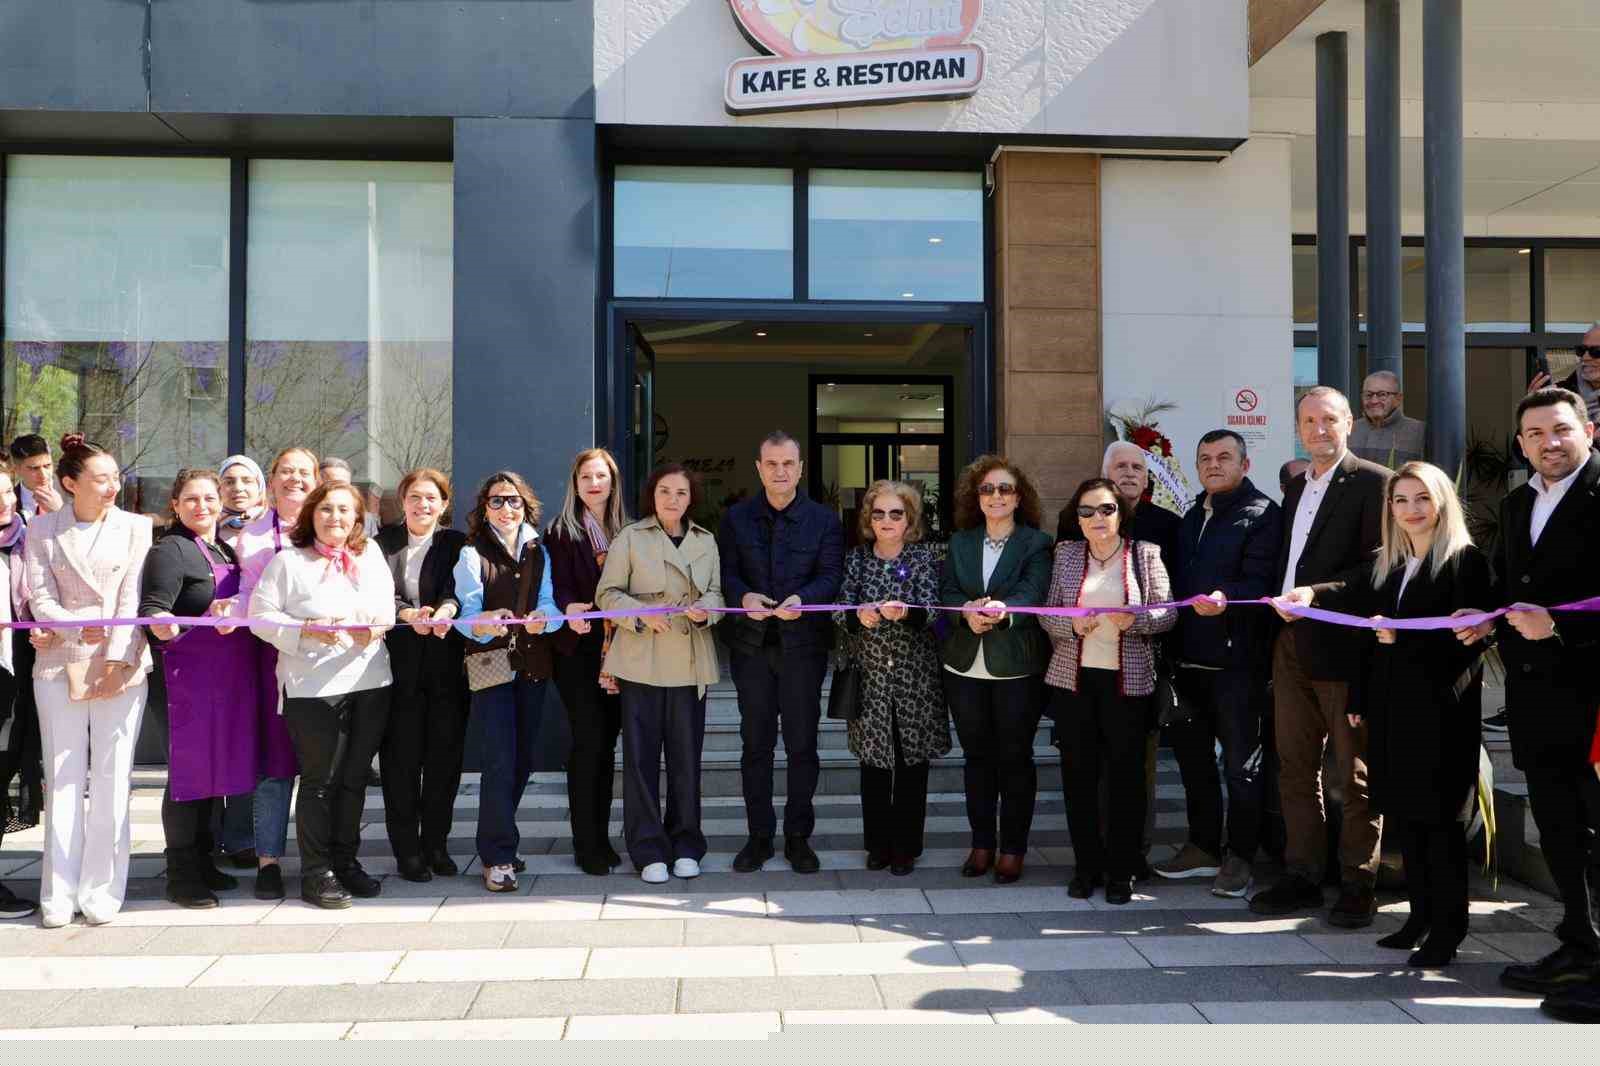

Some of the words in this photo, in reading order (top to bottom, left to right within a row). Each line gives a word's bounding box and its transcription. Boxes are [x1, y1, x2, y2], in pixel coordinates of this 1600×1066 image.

[742, 68, 806, 94] KAFE
[813, 67, 830, 88] &
[836, 57, 966, 87] RESTORAN
